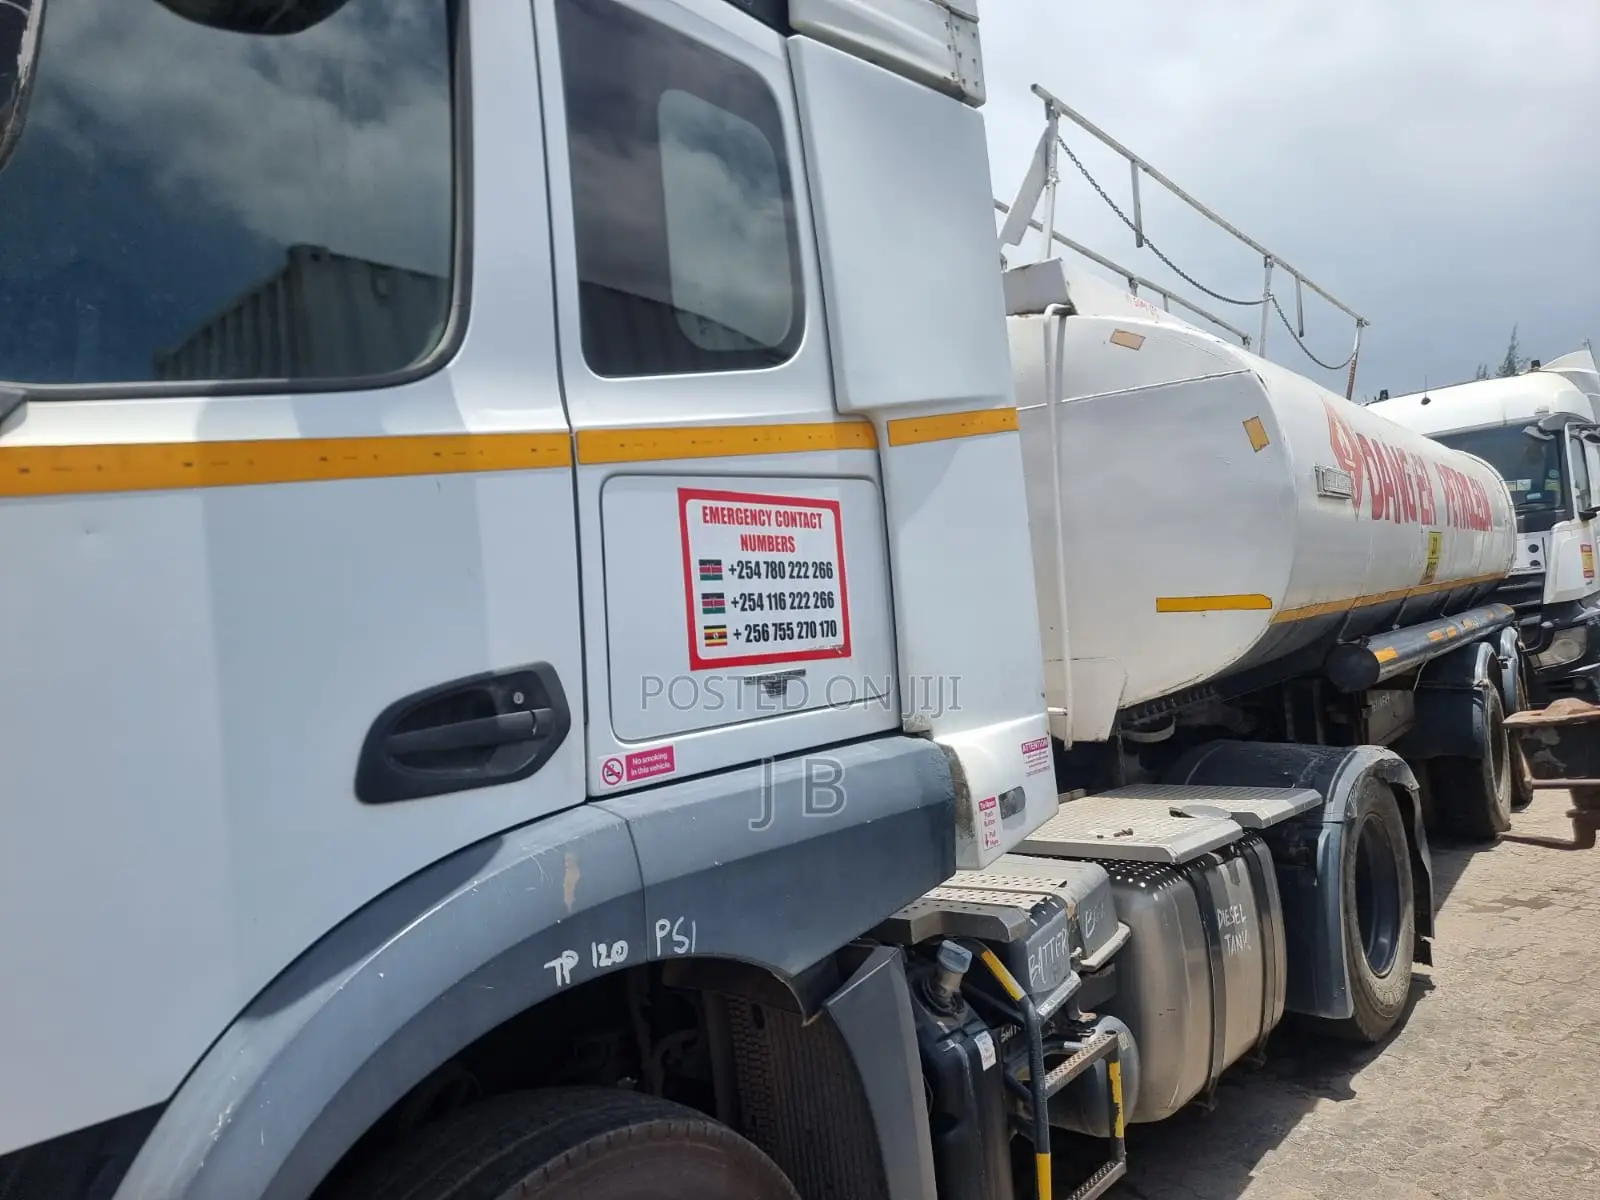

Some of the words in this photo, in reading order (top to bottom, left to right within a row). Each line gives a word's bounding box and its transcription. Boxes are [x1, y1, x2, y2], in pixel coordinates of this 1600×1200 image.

[1356, 432, 1437, 525] DANGER
[702, 505, 772, 528] EMERGENCY
[775, 510, 823, 529] CONTACT
[740, 534, 795, 553] NUMBERS
[728, 560, 761, 580] +254
[764, 561, 785, 579] 780
[788, 561, 809, 579] 222
[812, 561, 833, 579] 266
[731, 593, 764, 612] +254
[766, 593, 786, 611] 116
[789, 592, 811, 610] 222
[813, 591, 835, 609] 266
[745, 623, 770, 643] 256
[772, 622, 794, 641] 755
[797, 621, 817, 640] 270
[819, 620, 837, 638] 170
[632, 758, 642, 766] No
[642, 752, 668, 764] smoking
[638, 765, 649, 774] this
[650, 762, 671, 772] vehicle
[1217, 903, 1247, 930] DIESEL
[543, 949, 579, 987] TP
[591, 940, 629, 969] 120
[655, 916, 697, 957] PSI
